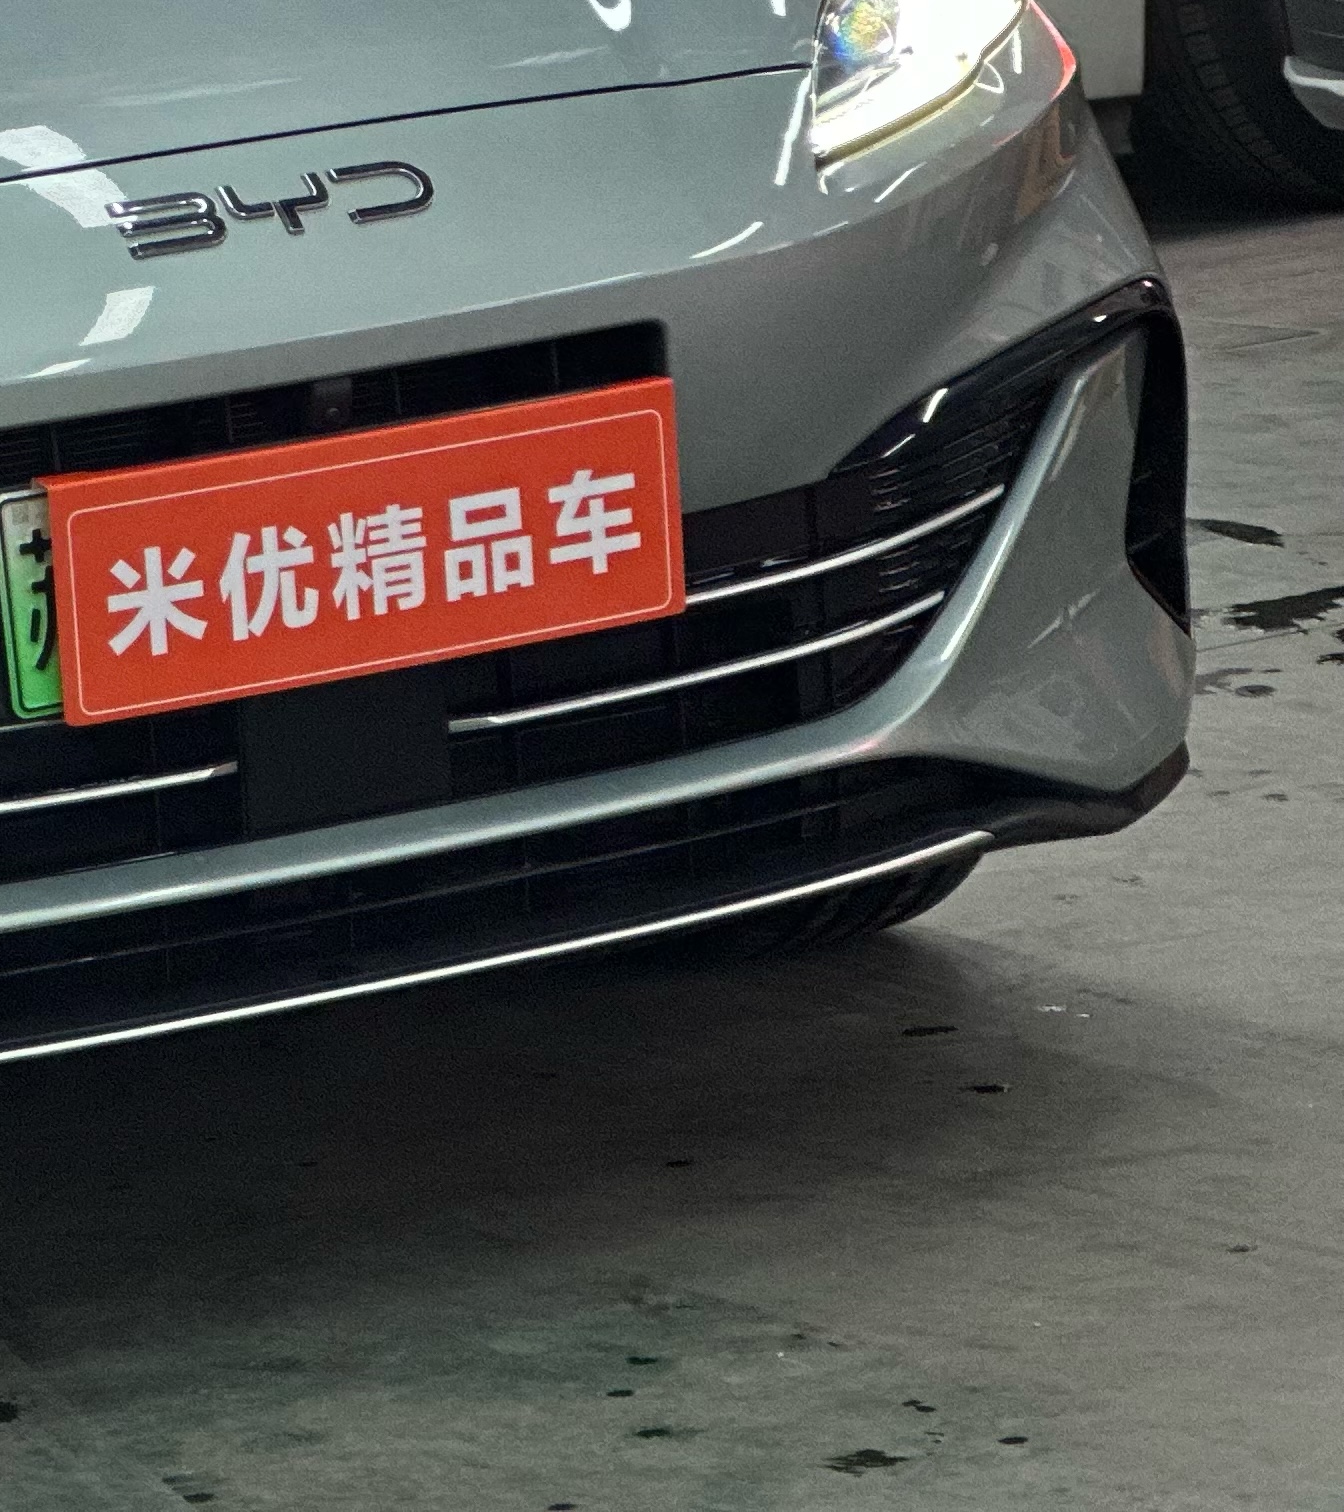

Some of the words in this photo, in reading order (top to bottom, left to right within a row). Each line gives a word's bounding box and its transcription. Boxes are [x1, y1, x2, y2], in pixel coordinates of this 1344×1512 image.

[105, 160, 435, 260] BYD
[107, 469, 642, 656] 米优精品车
